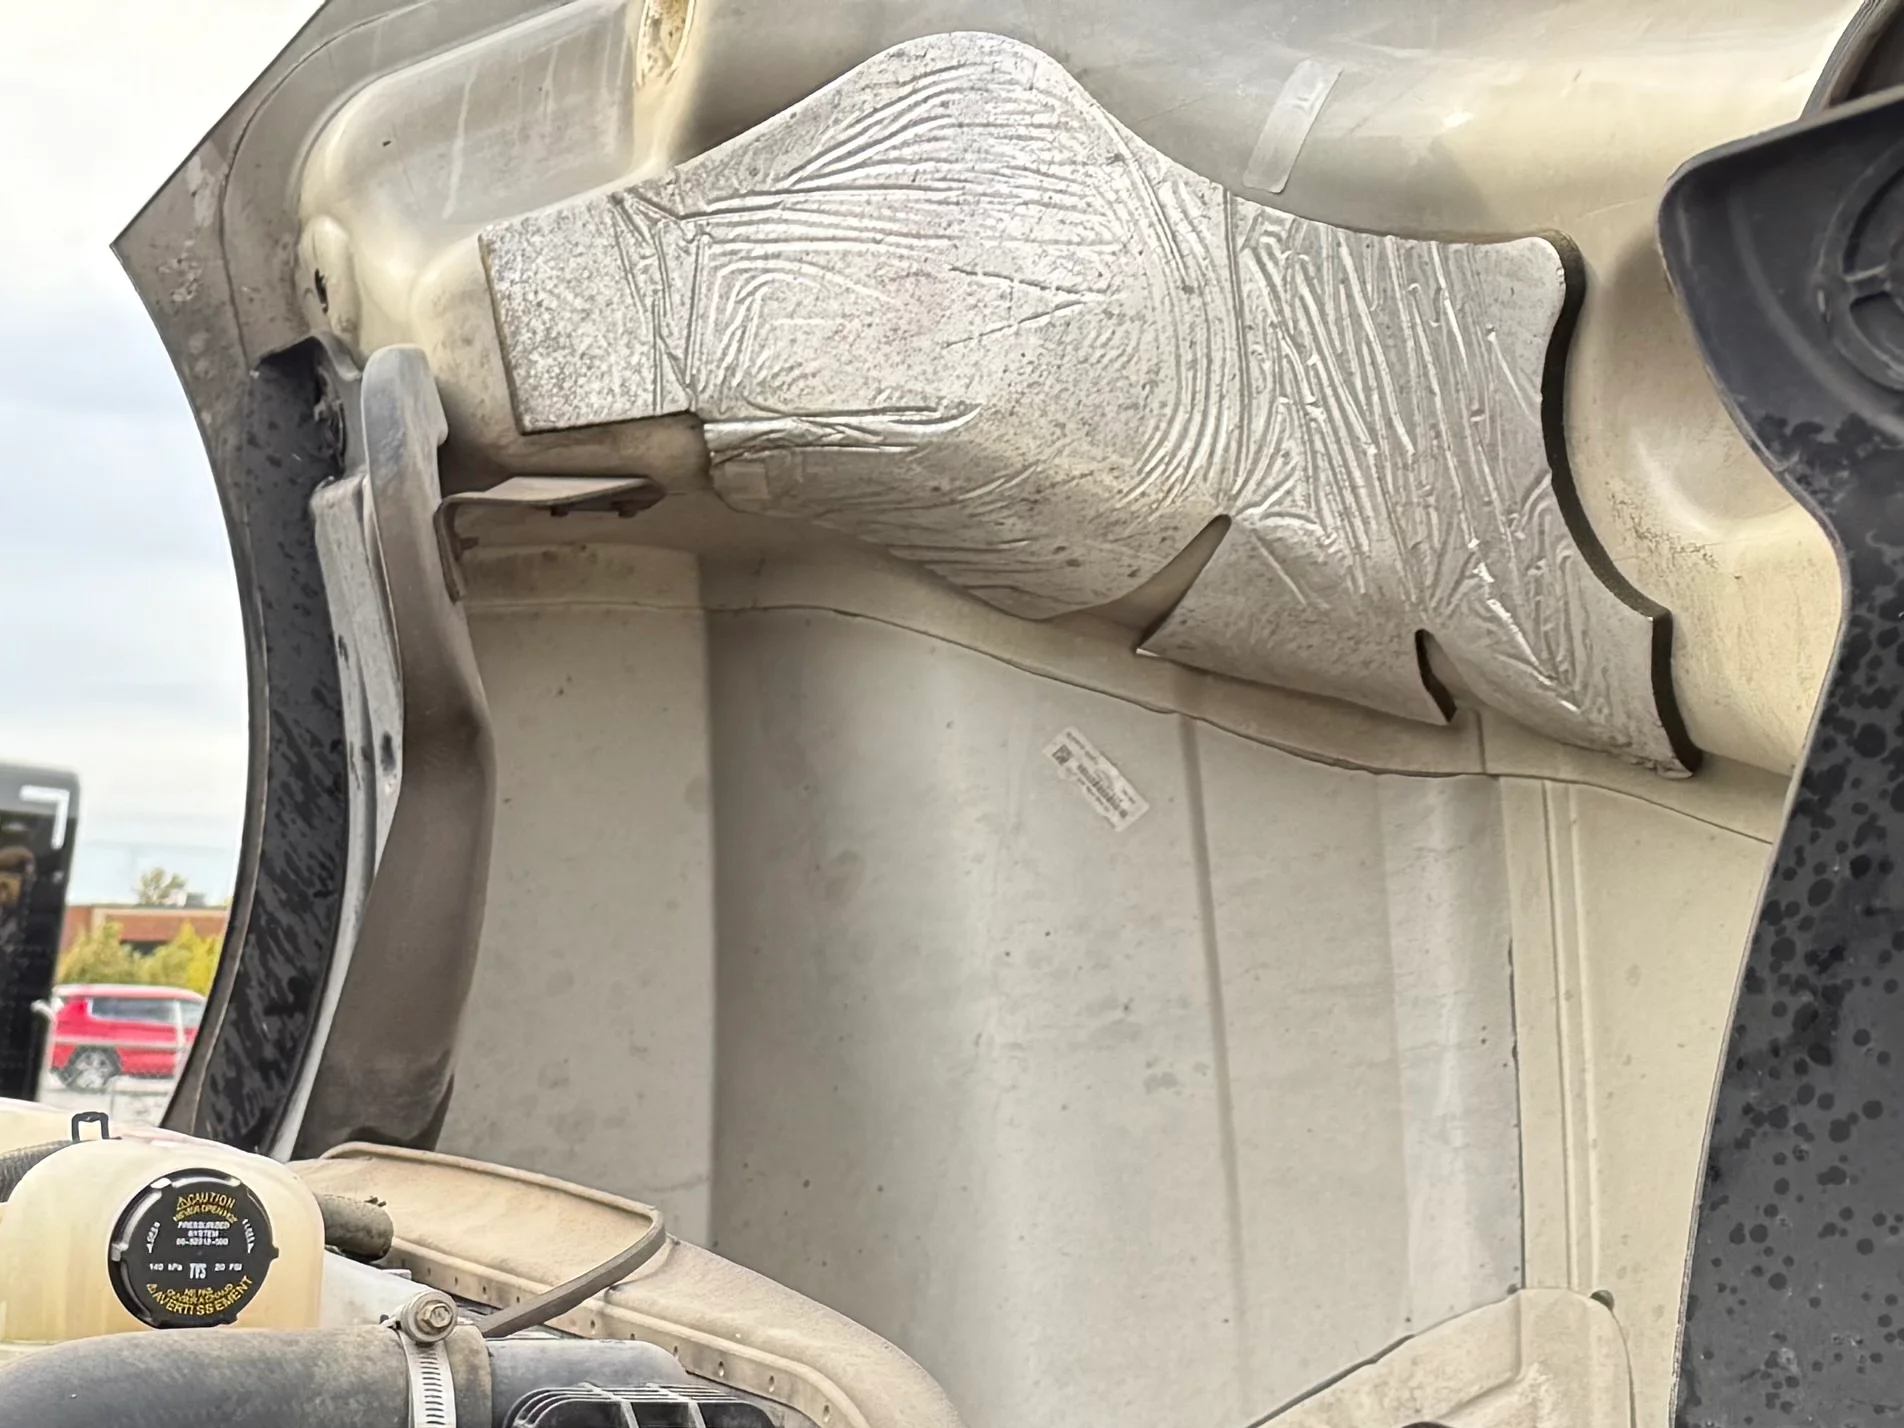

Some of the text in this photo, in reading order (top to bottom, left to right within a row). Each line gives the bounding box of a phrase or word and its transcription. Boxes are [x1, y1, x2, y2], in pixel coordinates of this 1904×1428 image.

[187, 1191, 236, 1209] CAUTION
[167, 1263, 183, 1272] kPa
[228, 1263, 243, 1271] PSI
[151, 1275, 253, 1316] AVERTISSEMENT
